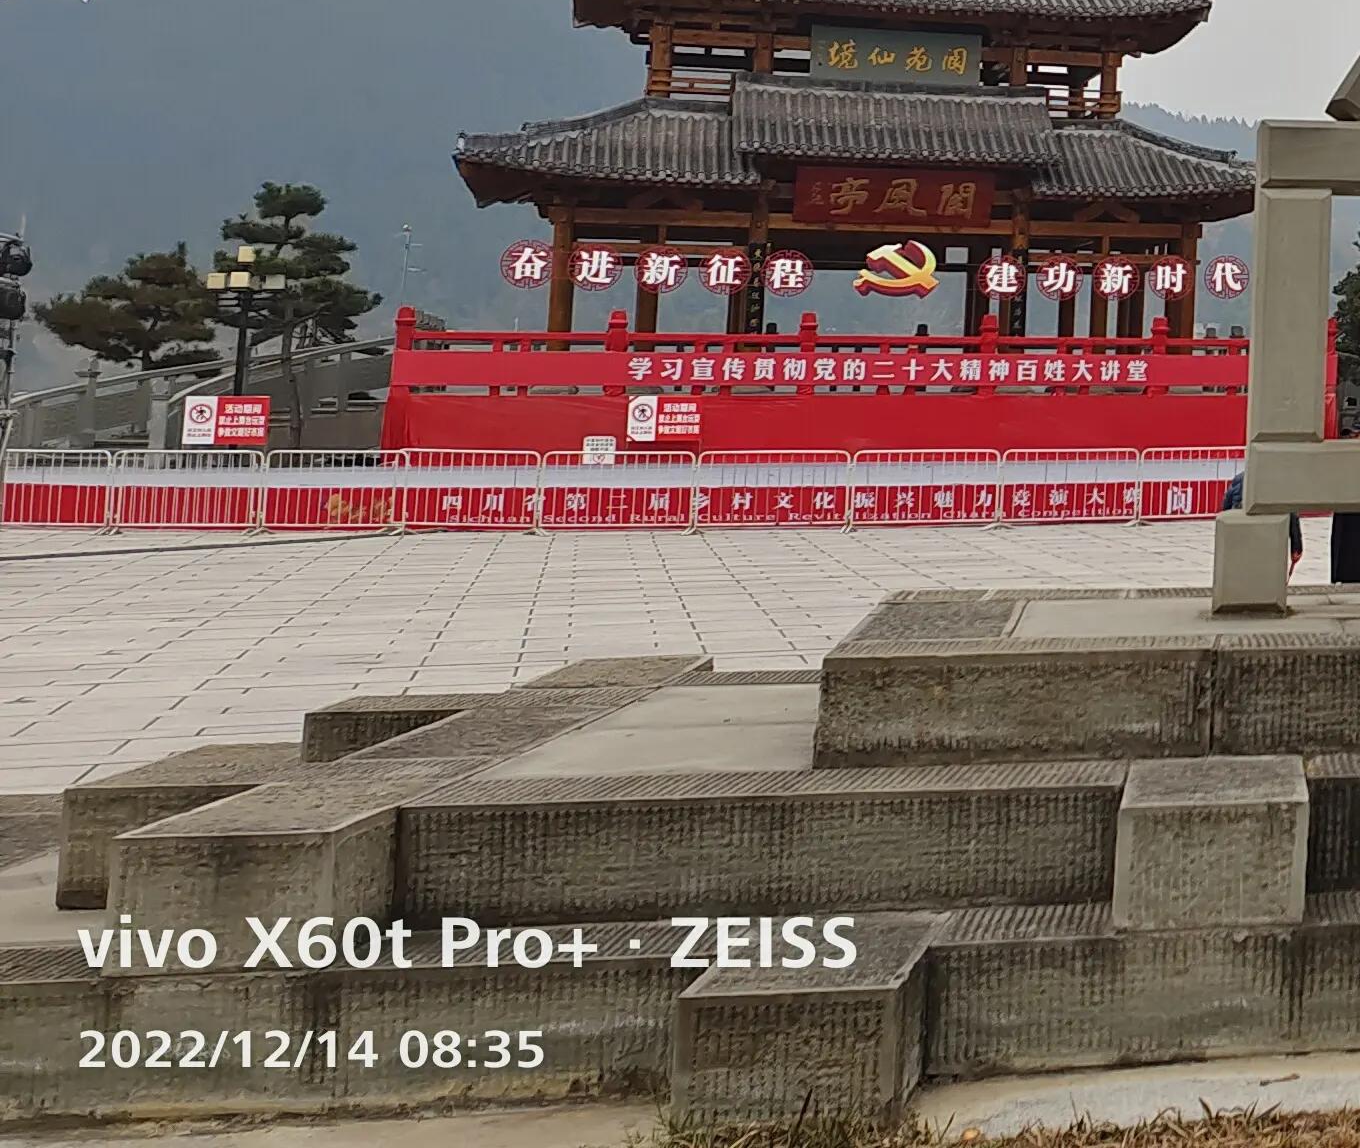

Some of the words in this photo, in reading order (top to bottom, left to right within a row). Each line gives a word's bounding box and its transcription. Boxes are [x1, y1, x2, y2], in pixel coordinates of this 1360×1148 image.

[510, 247, 805, 289] 奋进新征程
[984, 262, 1243, 294] 建功新时代
[628, 357, 1148, 383] 学习宣传贯彻党的二十大精神百姓大讲堂
